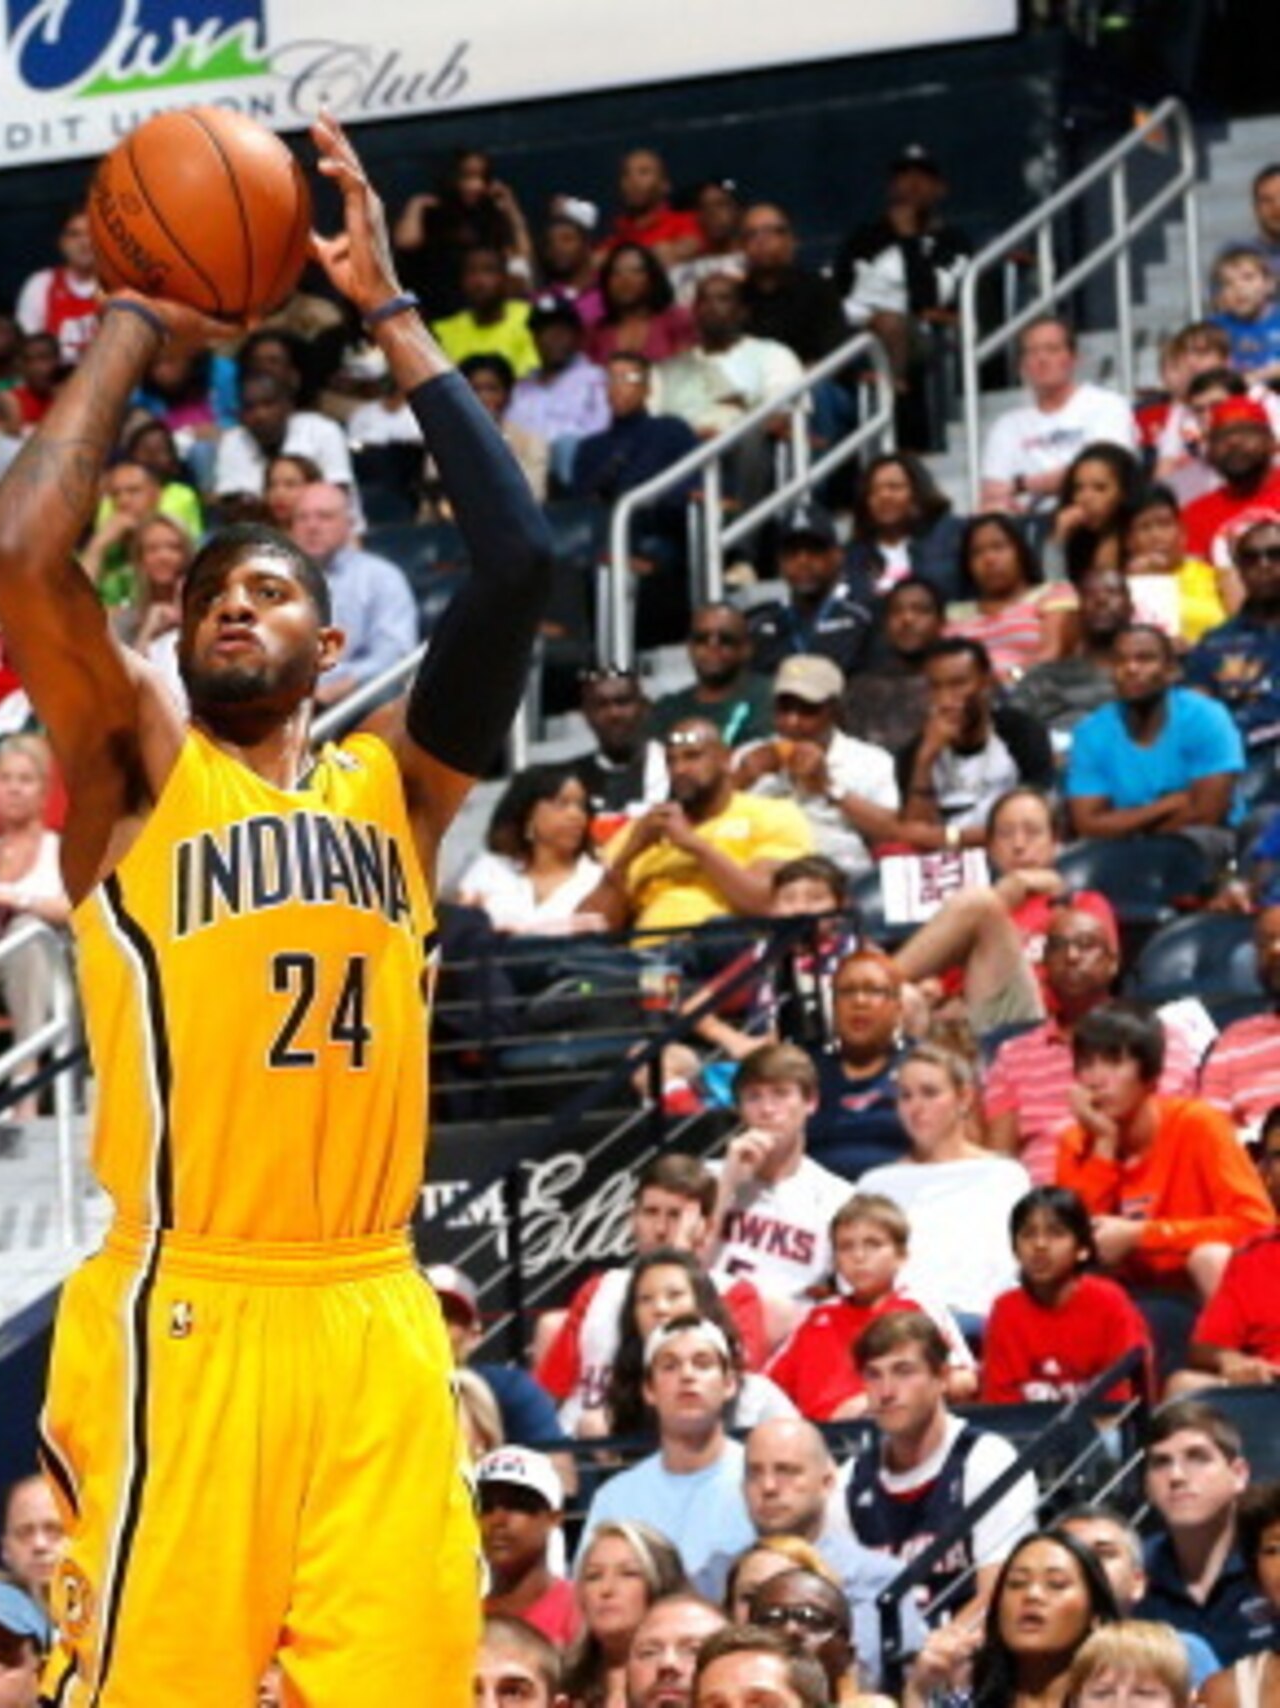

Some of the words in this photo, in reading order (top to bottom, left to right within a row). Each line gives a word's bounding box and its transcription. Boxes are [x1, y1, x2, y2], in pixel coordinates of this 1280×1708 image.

[13, 0, 273, 93] Own
[110, 92, 276, 138] UON
[268, 38, 471, 120] Club
[174, 810, 416, 940] INDIANA
[267, 950, 373, 1074] 24
